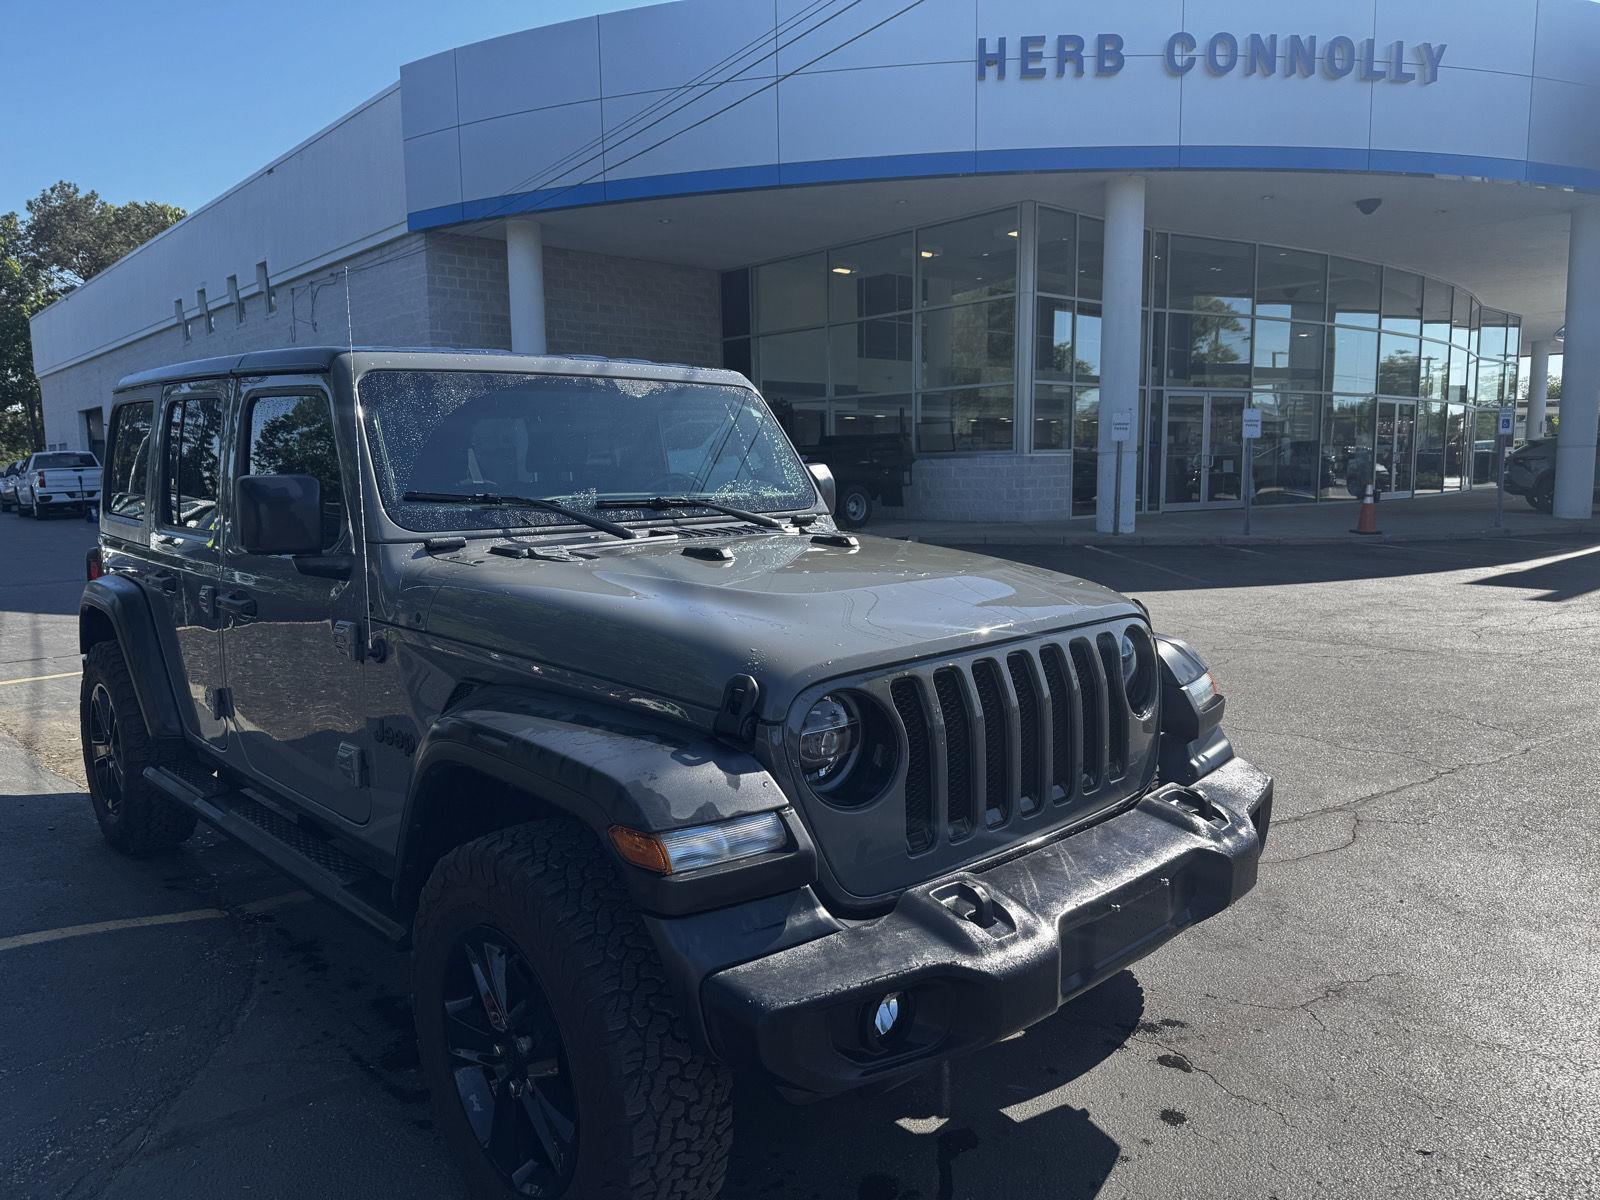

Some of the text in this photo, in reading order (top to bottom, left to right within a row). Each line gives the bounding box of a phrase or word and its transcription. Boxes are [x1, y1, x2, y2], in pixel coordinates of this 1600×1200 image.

[977, 31, 1447, 85] HERB CONNOLLY
[374, 719, 416, 757] Jeep
